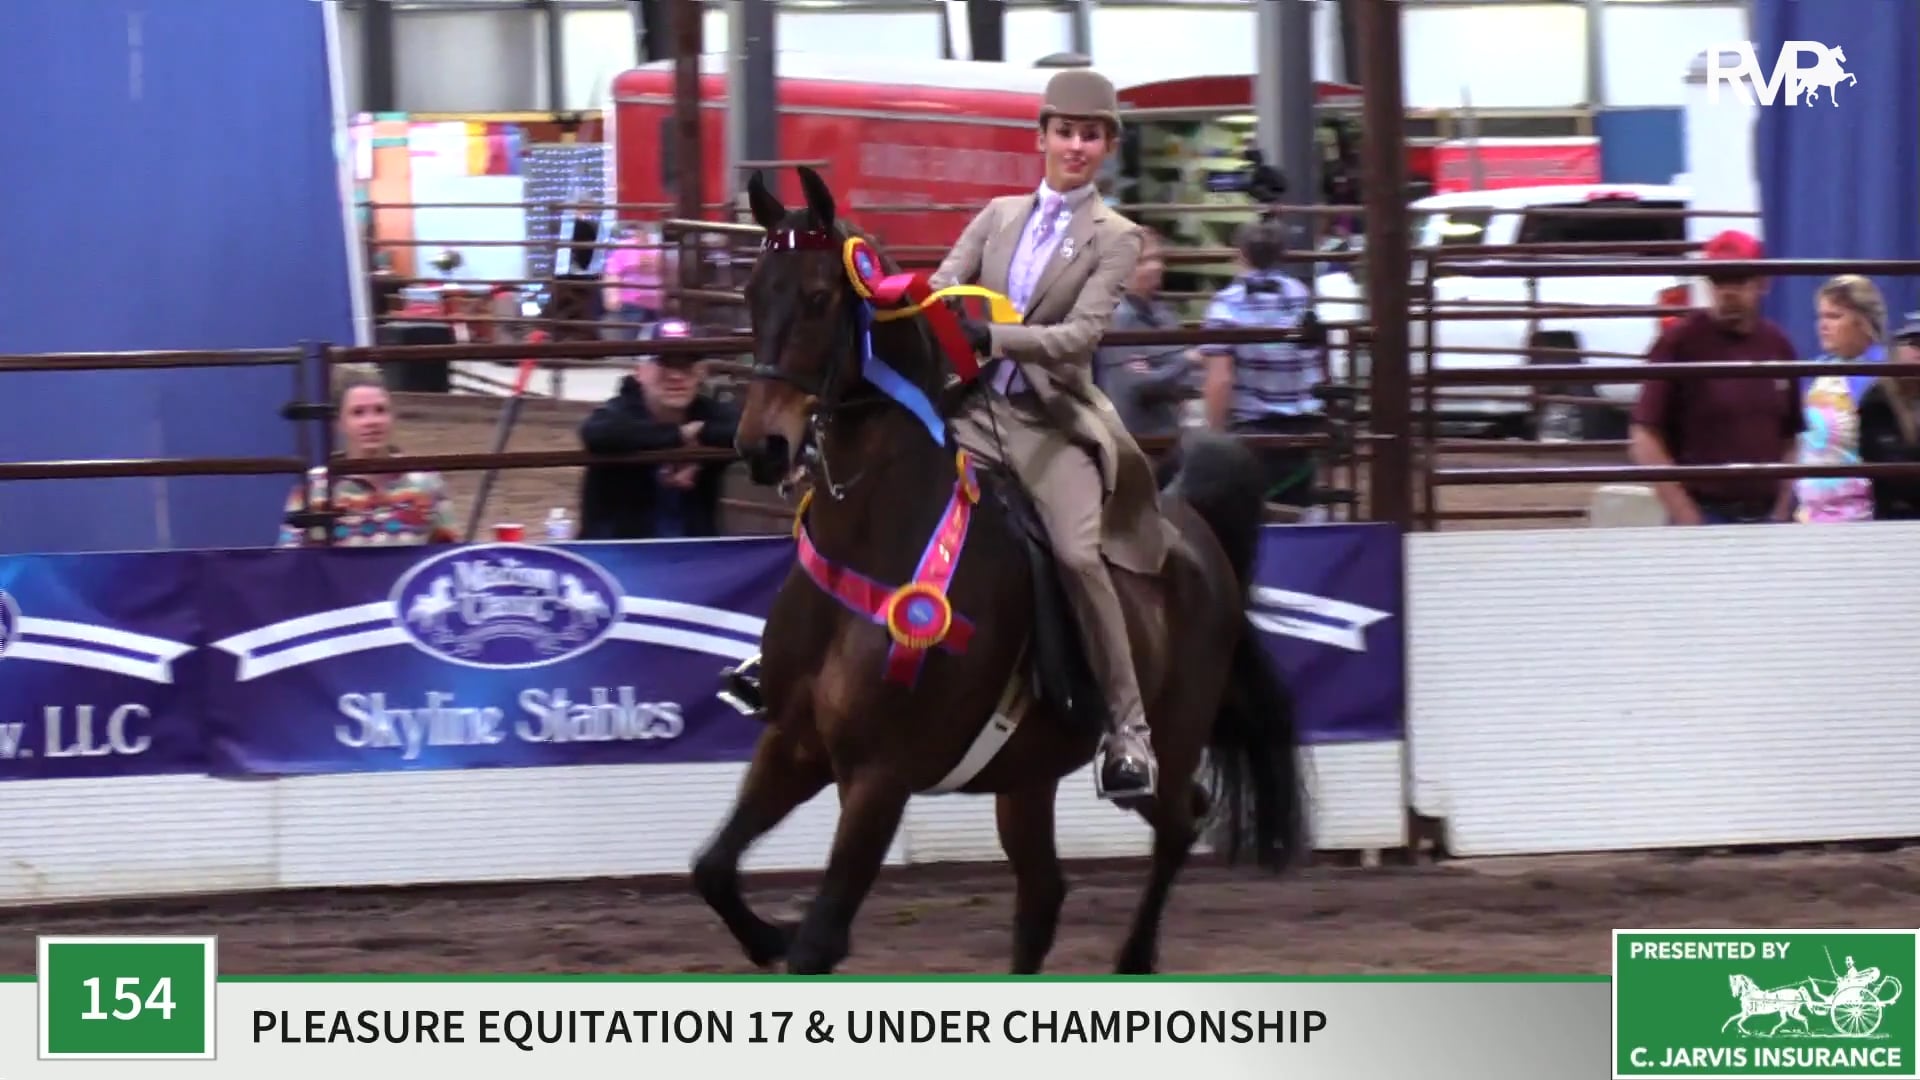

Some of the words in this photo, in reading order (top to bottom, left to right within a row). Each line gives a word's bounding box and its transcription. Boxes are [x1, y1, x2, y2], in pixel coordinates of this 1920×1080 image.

[43, 703, 152, 757] LLC
[335, 691, 506, 761] Skyline
[516, 685, 686, 743] Stables
